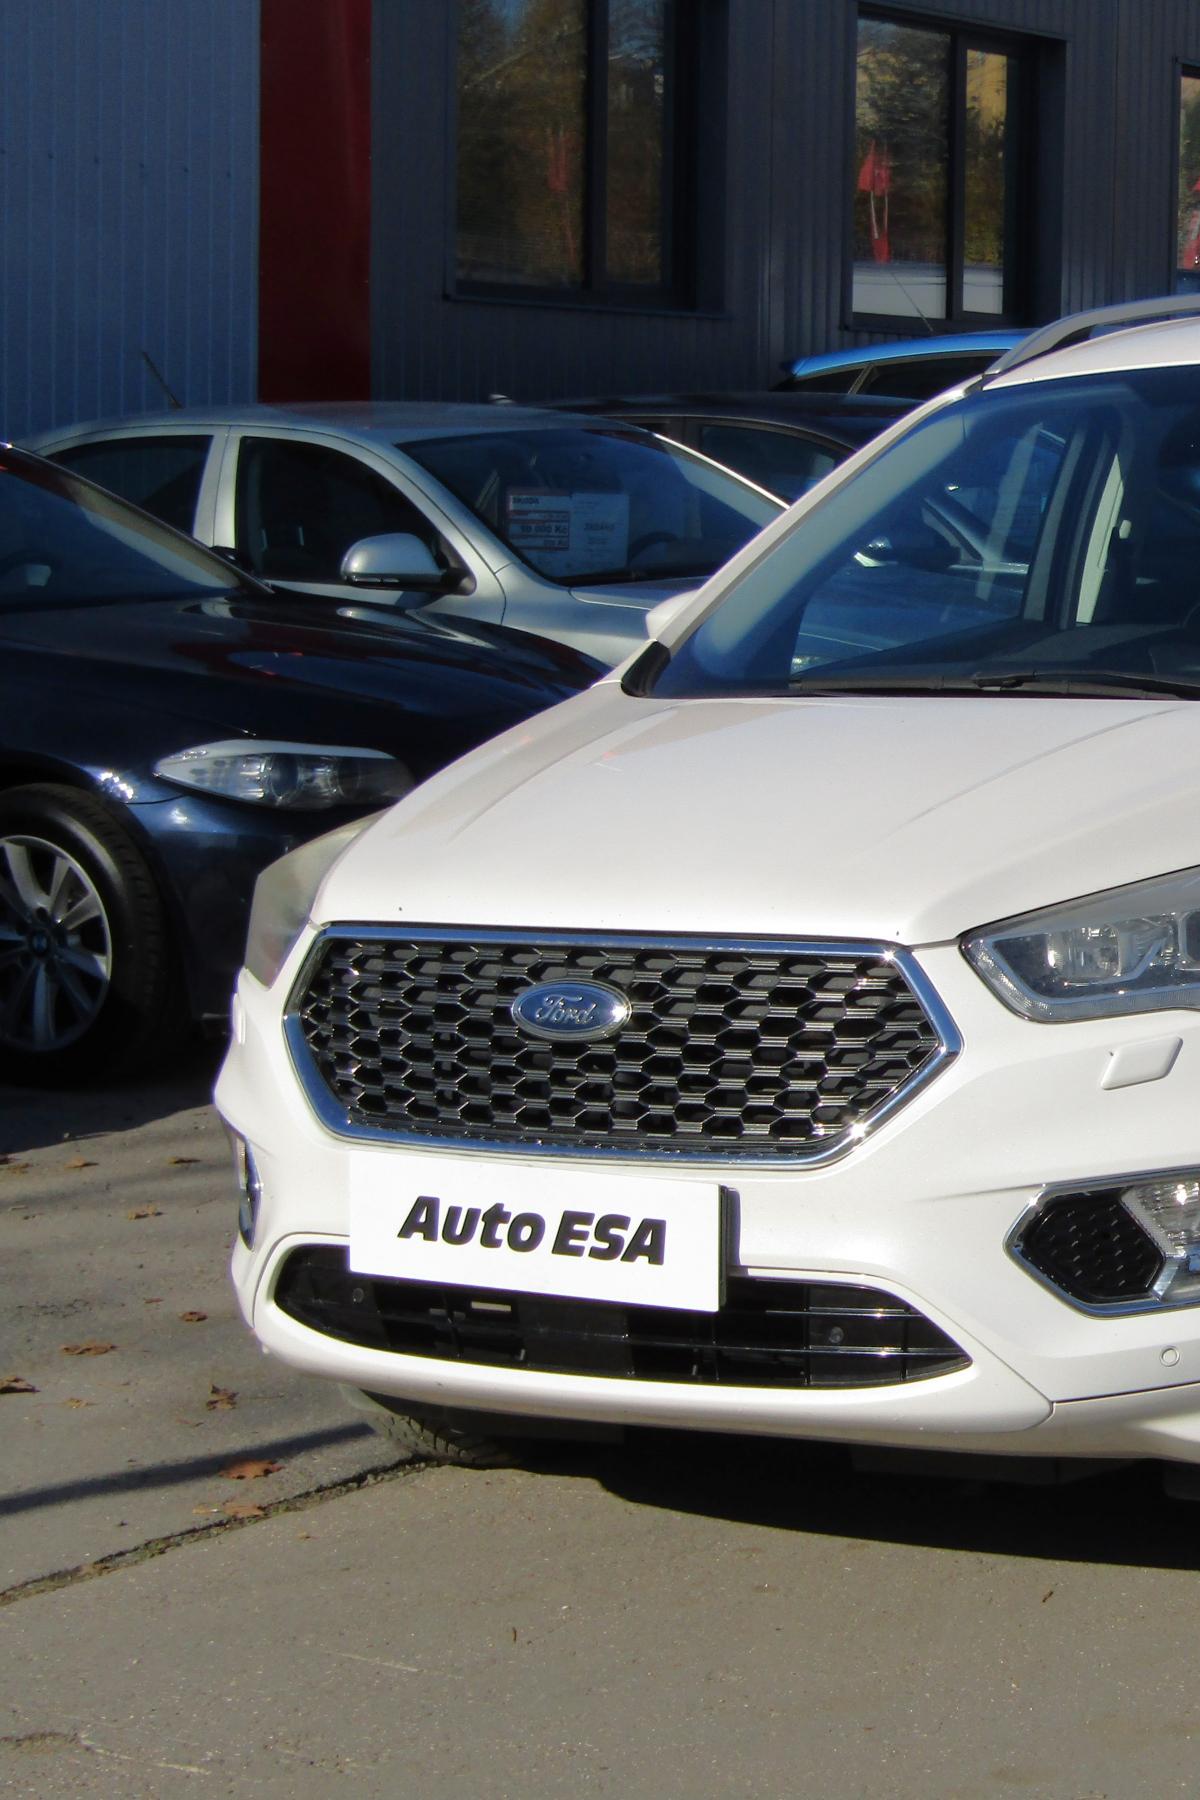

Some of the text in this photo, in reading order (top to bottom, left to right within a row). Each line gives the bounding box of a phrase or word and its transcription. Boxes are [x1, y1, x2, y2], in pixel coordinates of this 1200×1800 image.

[535, 994, 597, 1024] Ford
[397, 1195, 667, 1266] Auto ESA
